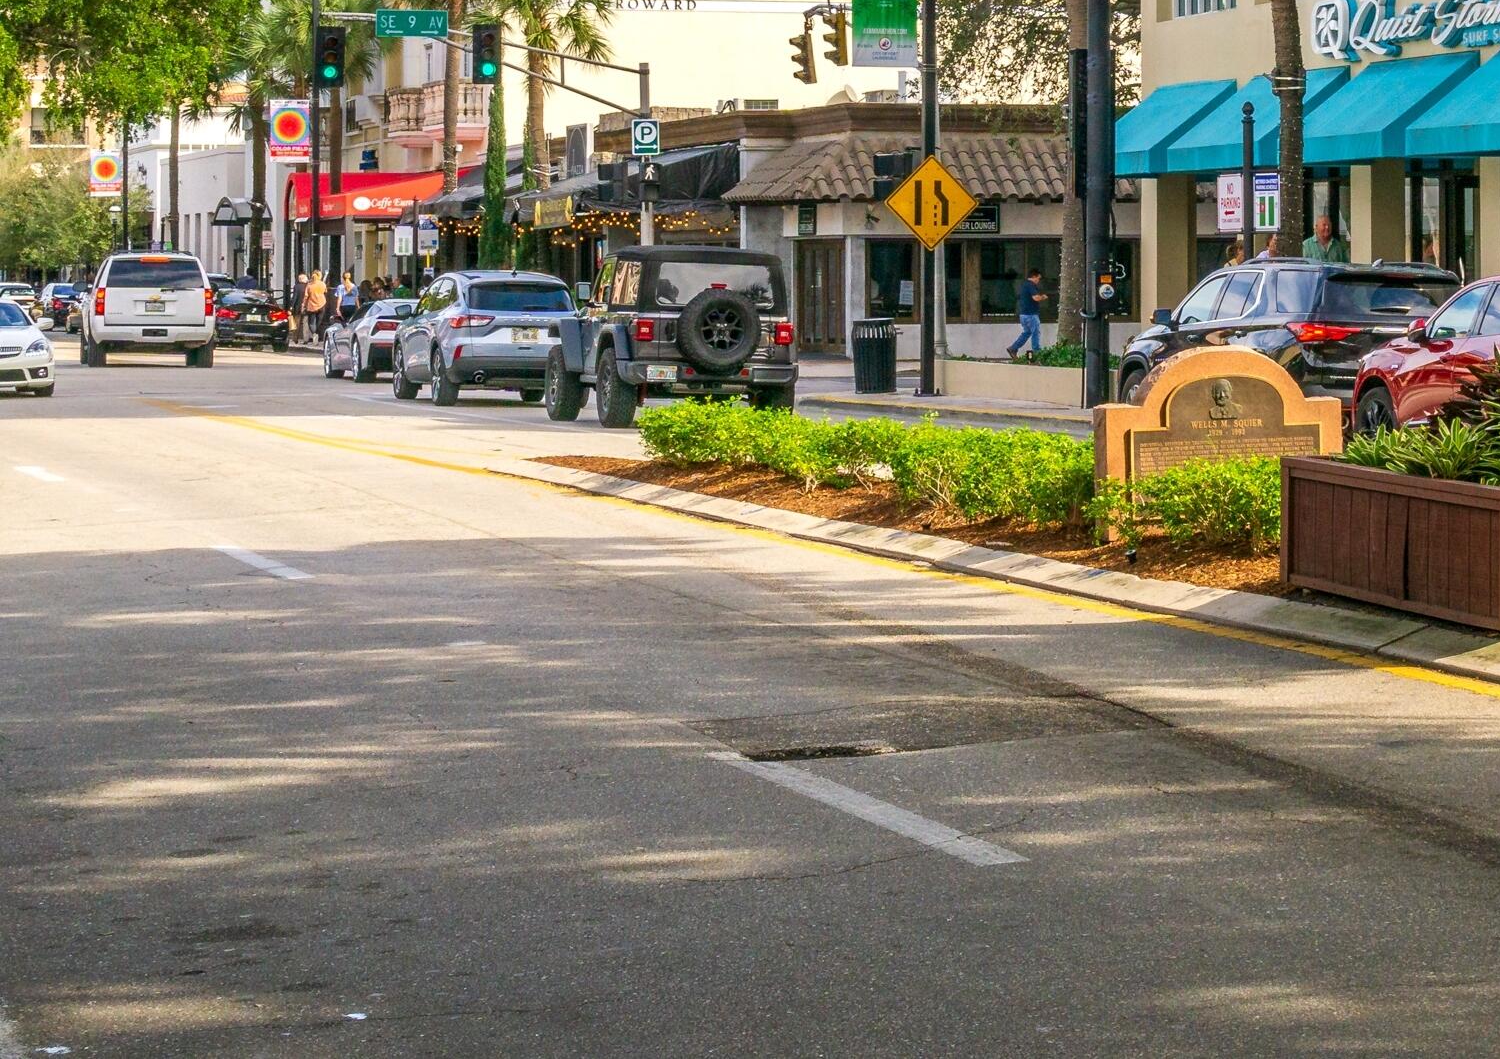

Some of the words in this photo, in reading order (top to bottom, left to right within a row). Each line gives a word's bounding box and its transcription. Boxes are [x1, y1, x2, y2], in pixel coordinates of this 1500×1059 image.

[380, 15, 396, 29] SE
[408, 15, 417, 29] 9
[429, 16, 444, 29] AV
[1462, 30, 1489, 45] SURF
[1226, 182, 1235, 195] NO
[370, 197, 393, 210] Caffe
[1220, 197, 1241, 209] PARKING
[970, 222, 996, 230] LOUNGE
[1190, 420, 1217, 429] WELLS
[1233, 418, 1262, 428] SQUIER
